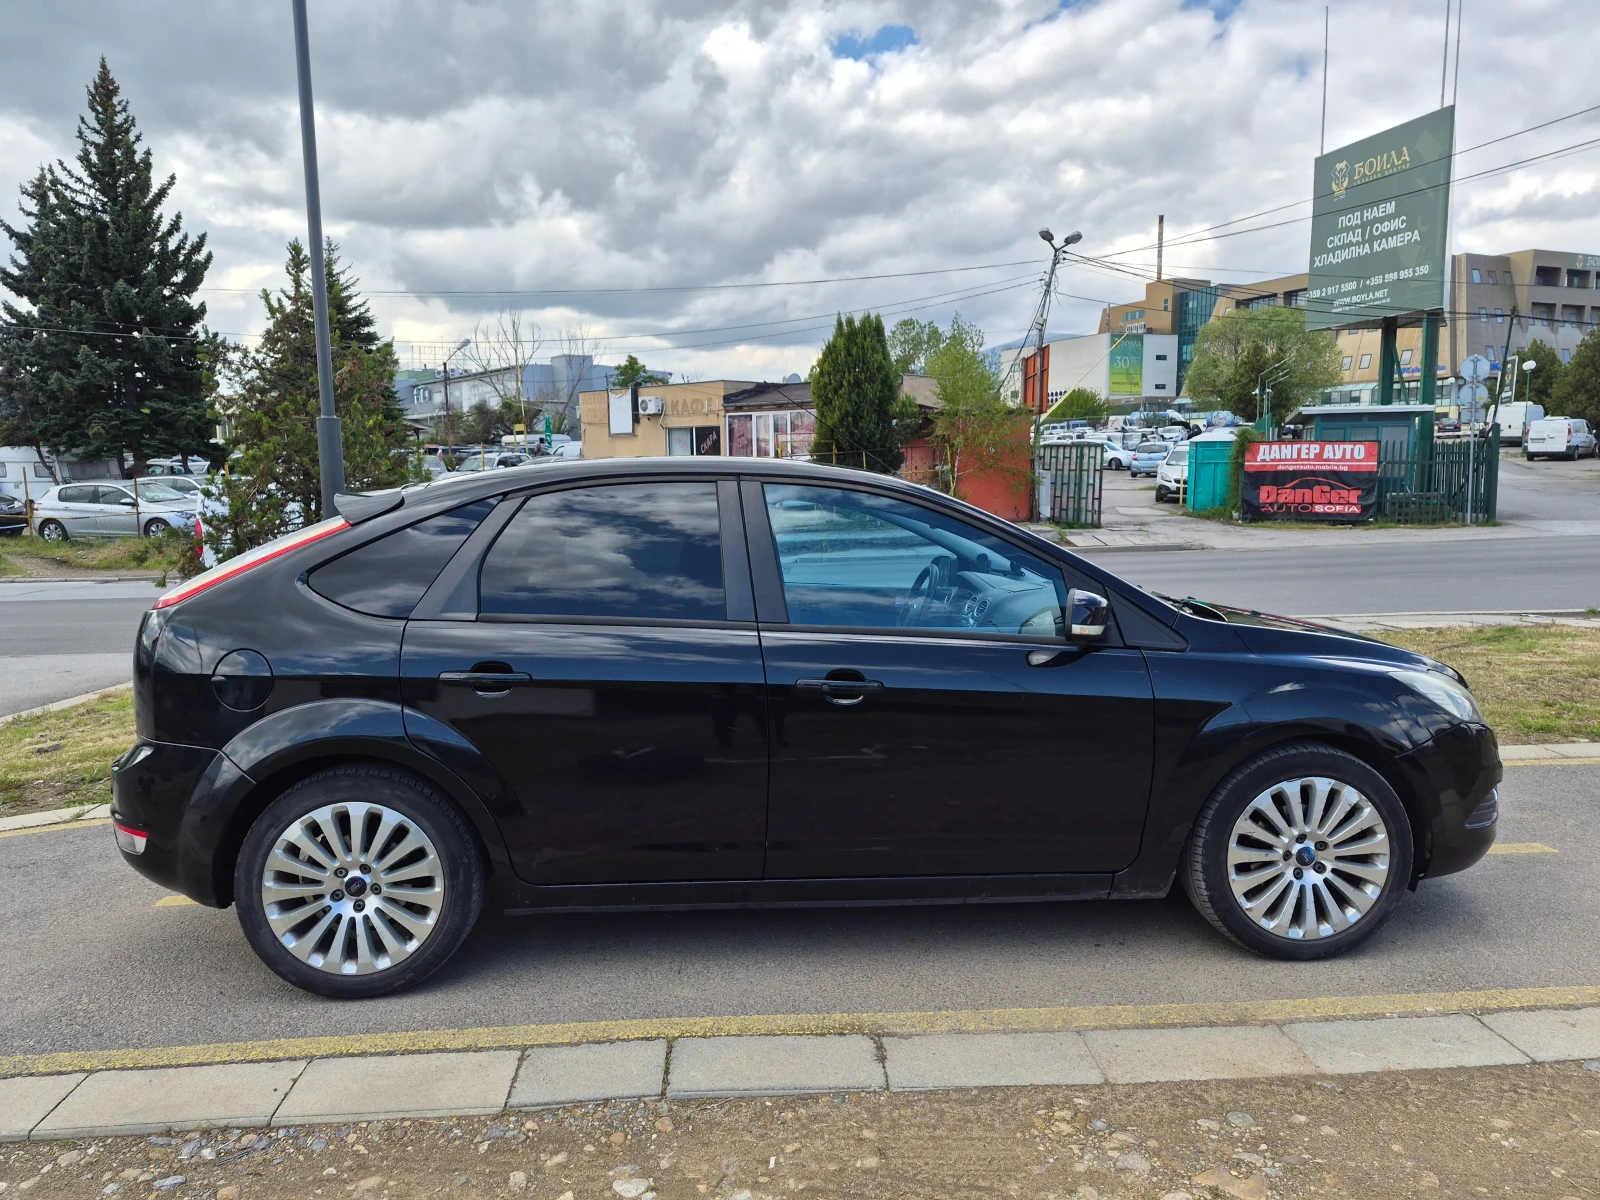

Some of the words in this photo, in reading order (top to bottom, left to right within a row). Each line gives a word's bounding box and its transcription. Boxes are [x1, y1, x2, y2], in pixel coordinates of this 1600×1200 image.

[1353, 146, 1411, 180] БОИЛА
[1338, 211, 1361, 229] ПОД
[1363, 201, 1396, 222] НАЕМ
[1326, 228, 1362, 248] СКЛАД
[1365, 226, 1370, 240] /
[1372, 215, 1407, 236] ОФИС
[1313, 242, 1371, 268] ХЛАДИЛНА
[1373, 230, 1421, 253] КАМЕРА
[1586, 256, 1600, 267] БО
[1321, 287, 1327, 297] 2
[1327, 284, 1340, 296] 917
[1340, 281, 1357, 292] 5500
[1365, 275, 1383, 286] +359
[1385, 271, 1398, 282] 888
[1399, 268, 1413, 279] 955
[1414, 265, 1429, 277] 350
[1114, 356, 1130, 369] 30
[670, 397, 713, 415] КАФЕ
[700, 430, 718, 454] СКАРА
[1257, 444, 1320, 462] ДАНГЕР
[1323, 444, 1365, 460] АУТО
